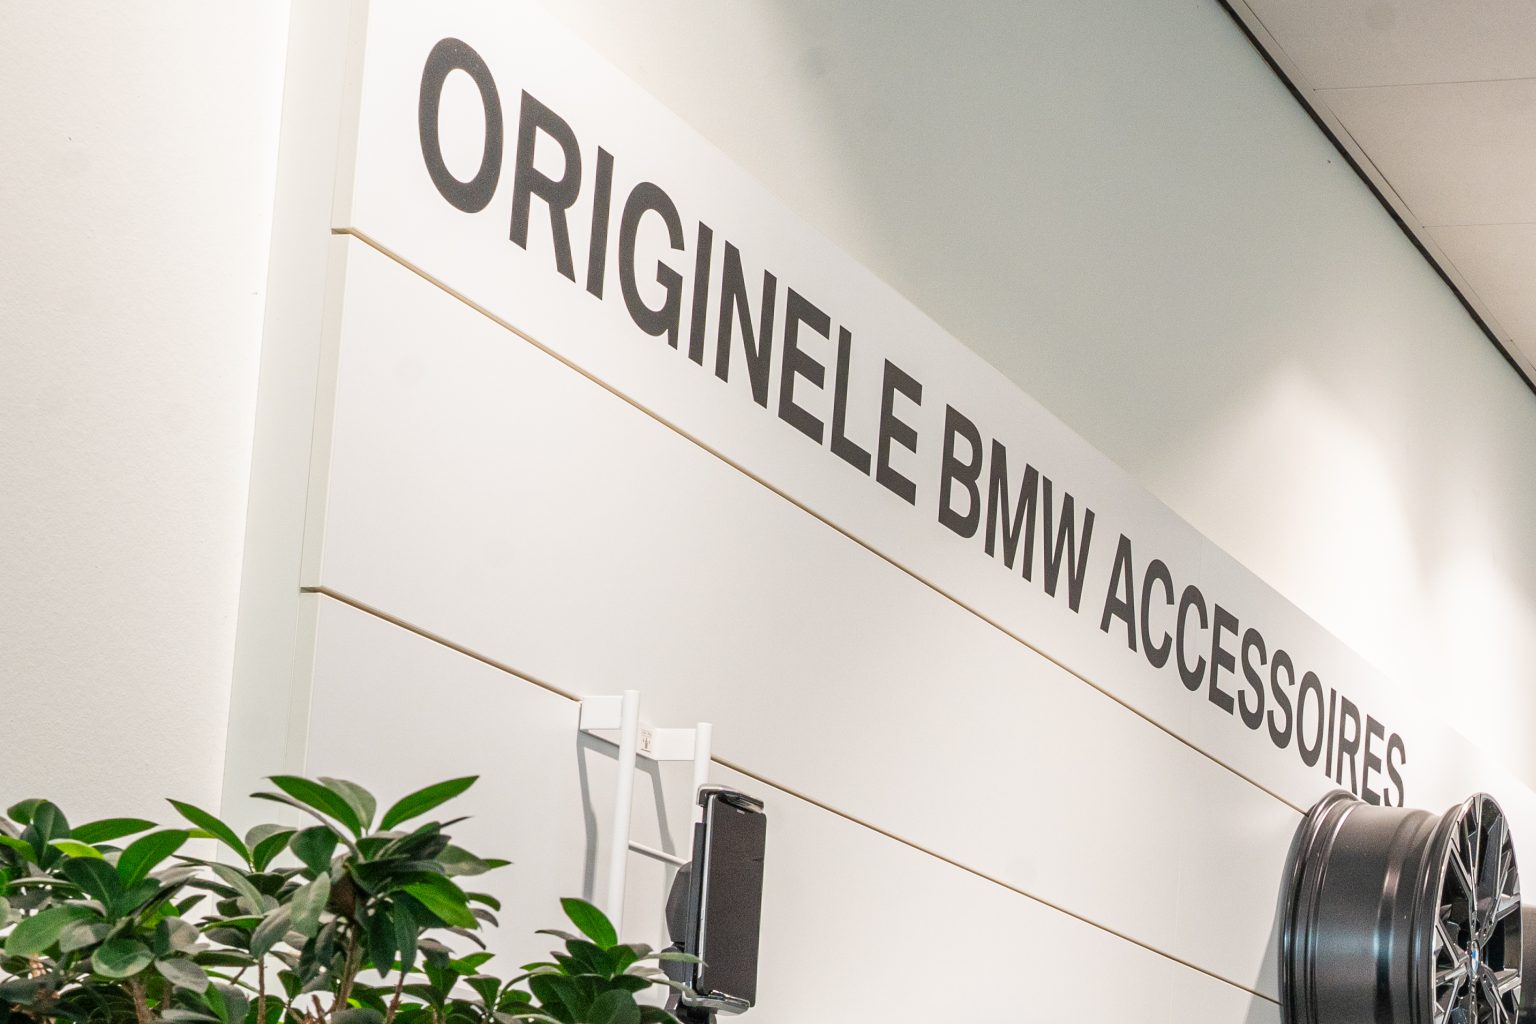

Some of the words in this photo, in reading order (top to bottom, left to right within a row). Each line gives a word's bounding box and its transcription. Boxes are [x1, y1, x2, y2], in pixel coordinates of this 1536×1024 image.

[418, 37, 923, 506] ORIGINELE
[938, 404, 1096, 614] BMW
[1100, 533, 1407, 809] ACCESSOIRES
